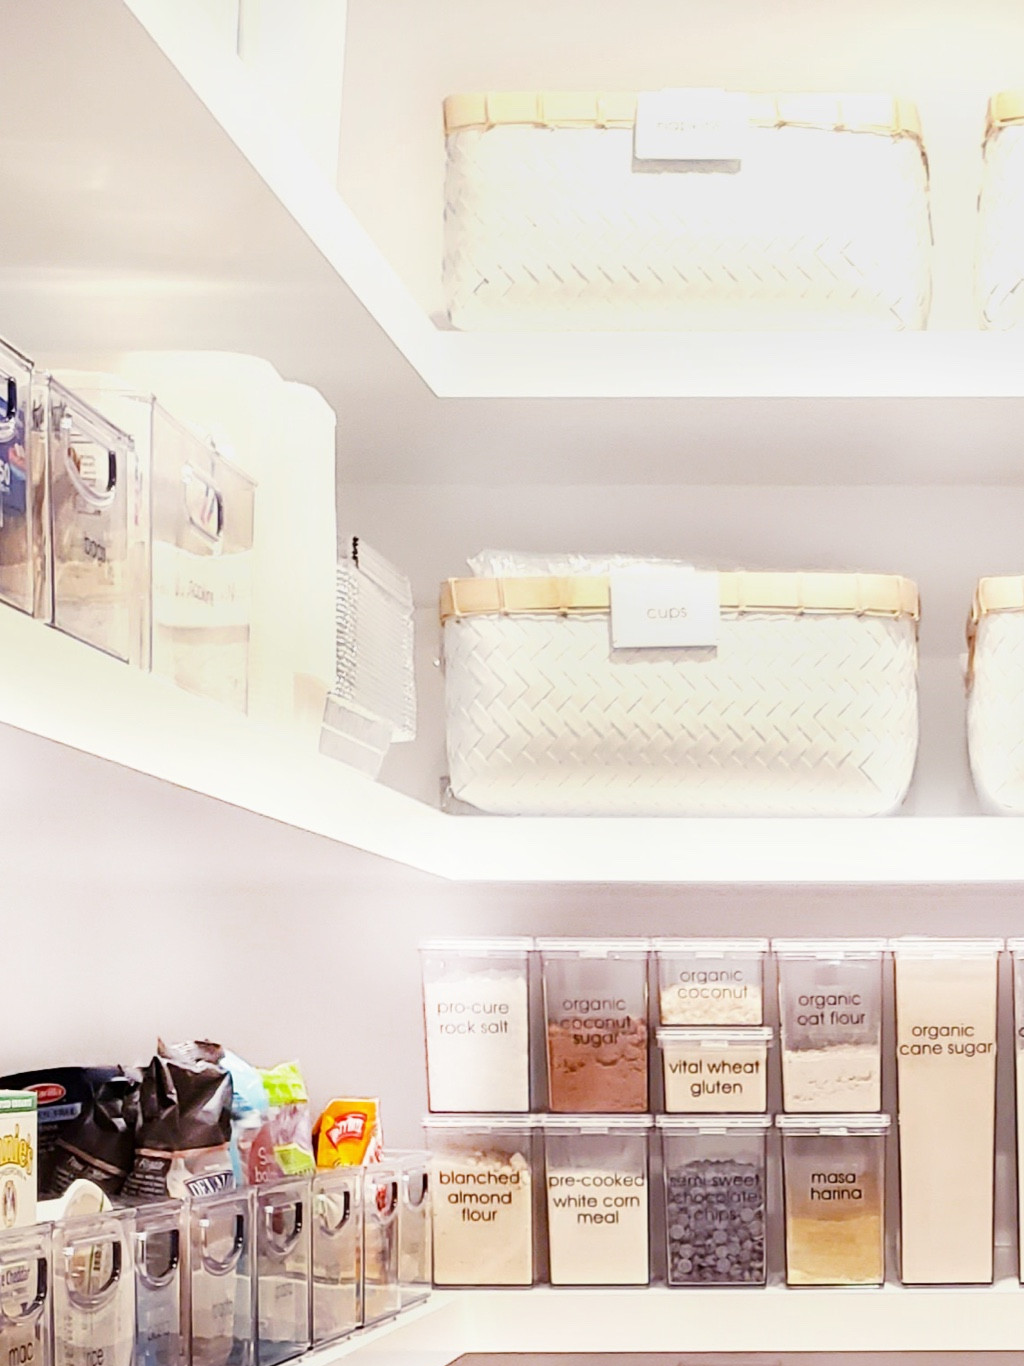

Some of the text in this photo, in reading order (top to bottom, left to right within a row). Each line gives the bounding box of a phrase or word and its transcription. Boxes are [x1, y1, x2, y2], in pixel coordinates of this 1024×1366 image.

[646, 606, 689, 624] cups
[679, 968, 744, 985] organic
[677, 984, 748, 999] coconut
[562, 998, 627, 1013] organic
[798, 993, 862, 1009] organic
[437, 1003, 510, 1016] pro-cure
[559, 1016, 632, 1030] coconut
[797, 1010, 866, 1026] oat flour
[440, 1020, 508, 1034] rock salt
[911, 1023, 975, 1040] organic
[572, 1031, 619, 1048] sugar
[899, 1042, 993, 1060] cane sugar
[669, 1059, 760, 1075] vital wheat
[690, 1079, 743, 1097] gluten
[439, 1170, 521, 1185] blanched
[548, 1174, 645, 1188] pre-cooked
[711, 1174, 760, 1187] sweet
[811, 1172, 857, 1185] masa
[447, 1191, 513, 1205] almond
[553, 1194, 640, 1208] white corn
[672, 1191, 758, 1204] chocolate
[810, 1186, 863, 1201] harina
[461, 1208, 497, 1222] flour
[577, 1210, 620, 1224] meal
[693, 1207, 738, 1223] chips
[8, 1342, 34, 1366] mac
